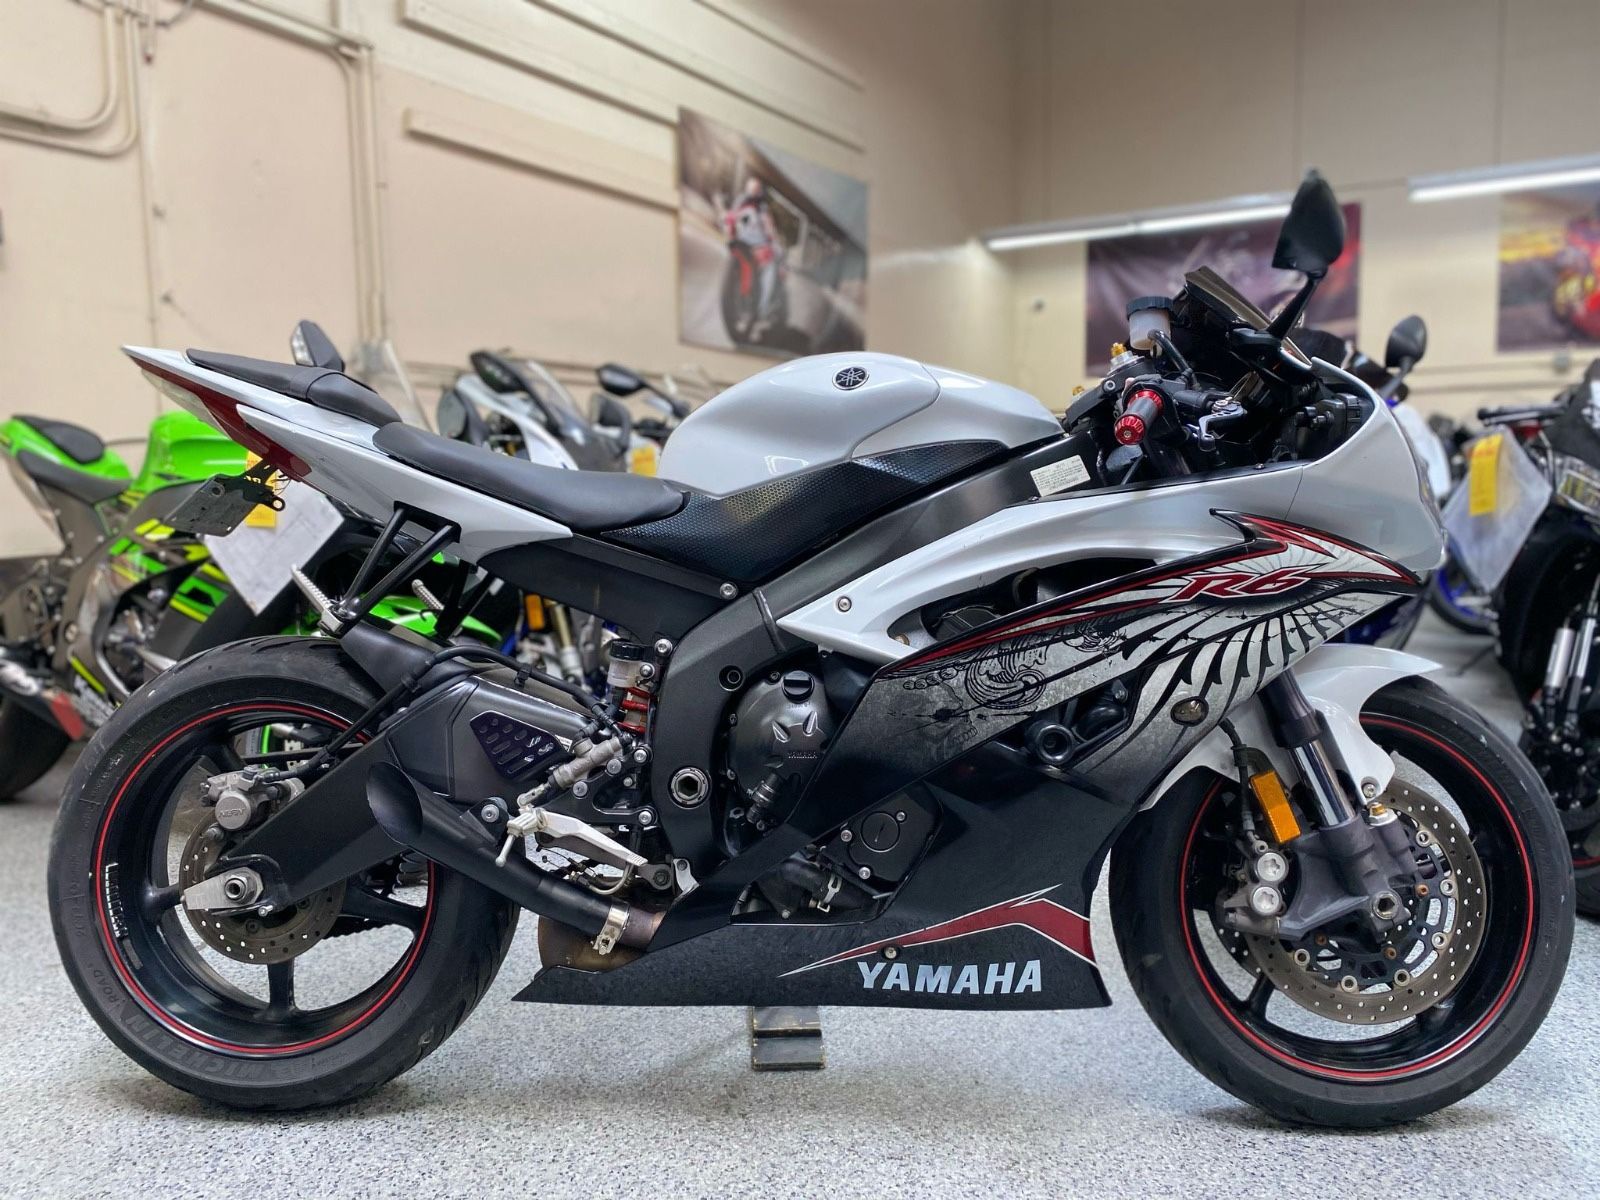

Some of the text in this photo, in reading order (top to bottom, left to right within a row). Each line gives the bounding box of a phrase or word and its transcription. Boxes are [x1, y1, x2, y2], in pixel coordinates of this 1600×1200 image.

[1164, 566, 1314, 602] R6
[857, 959, 1042, 995] YAMAHA
[93, 969, 264, 1078] MICHELIN ROAD
